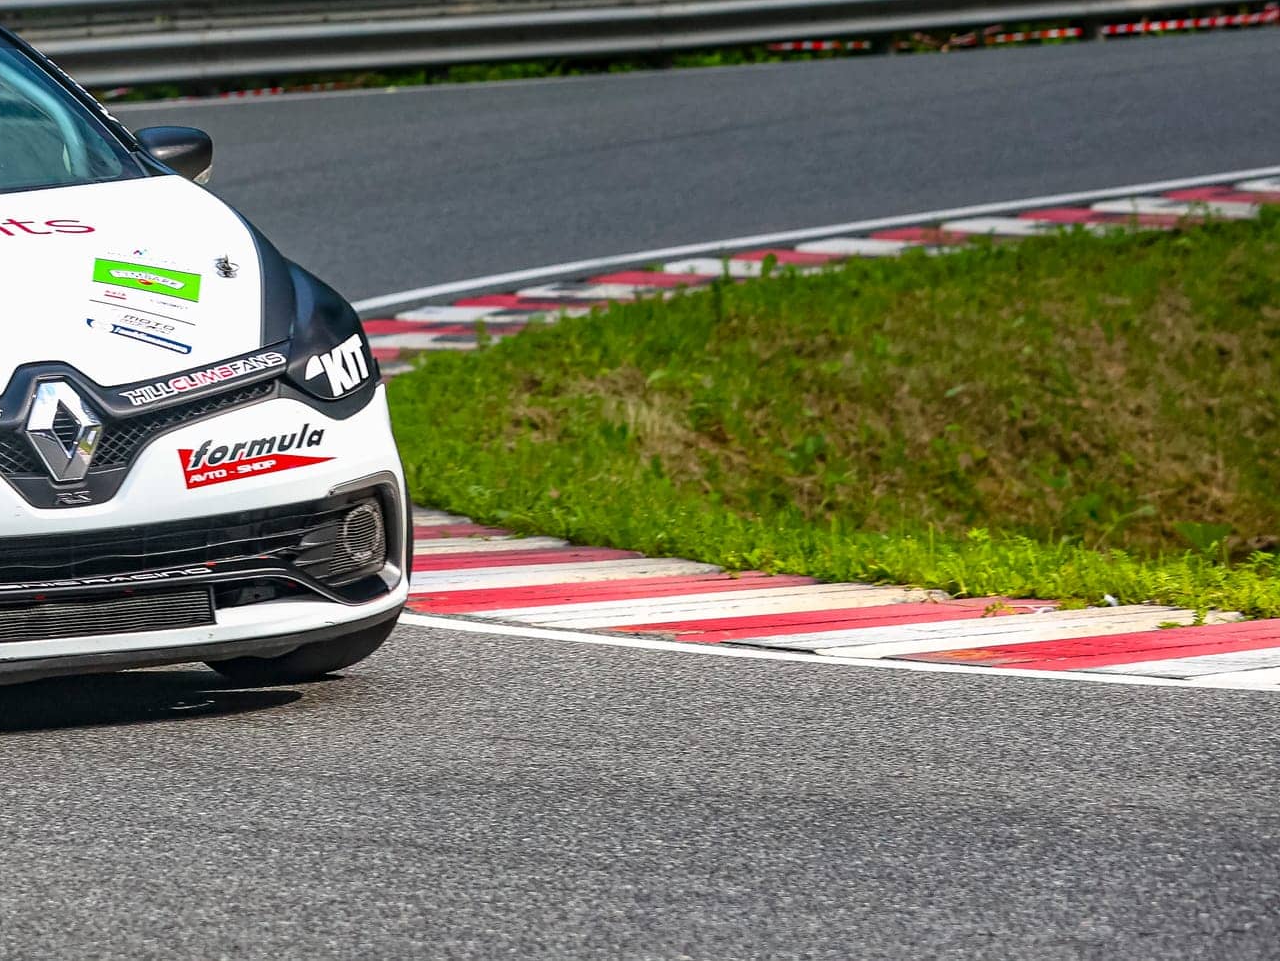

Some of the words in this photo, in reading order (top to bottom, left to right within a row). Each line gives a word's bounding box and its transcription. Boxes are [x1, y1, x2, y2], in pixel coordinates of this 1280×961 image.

[321, 333, 371, 398] KIT
[188, 423, 325, 471] formula
[237, 459, 276, 474] SHOP
